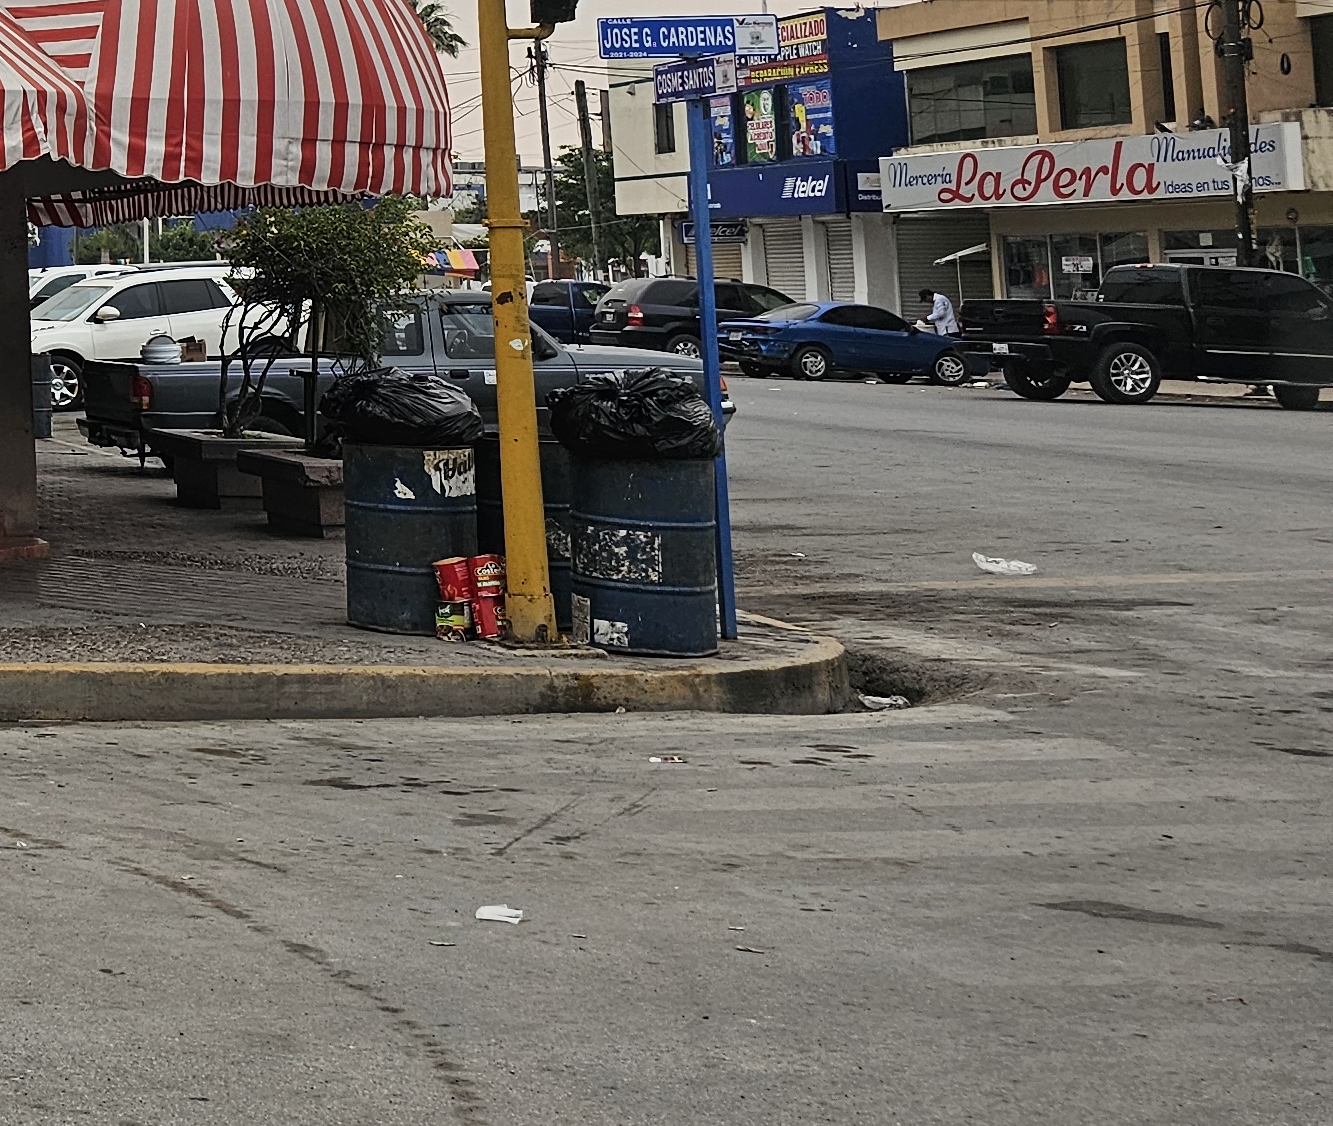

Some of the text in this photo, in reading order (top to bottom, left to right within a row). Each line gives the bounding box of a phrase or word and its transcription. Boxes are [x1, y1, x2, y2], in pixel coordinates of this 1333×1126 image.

[604, 25, 734, 49] JOSE G. CARDENAS
[778, 18, 825, 43] CIALIZADO
[798, 40, 823, 58] WATCH
[657, 72, 683, 95] COSME
[684, 66, 714, 91] SANTOS
[1150, 127, 1276, 163] Manualides
[937, 140, 1162, 205] La Perla
[793, 174, 830, 198] telcel
[857, 193, 882, 201] Distribu
[1163, 180, 1193, 195] Ideas
[1196, 181, 1210, 193] en
[1212, 177, 1230, 192] tus
[709, 224, 743, 237] elcel
